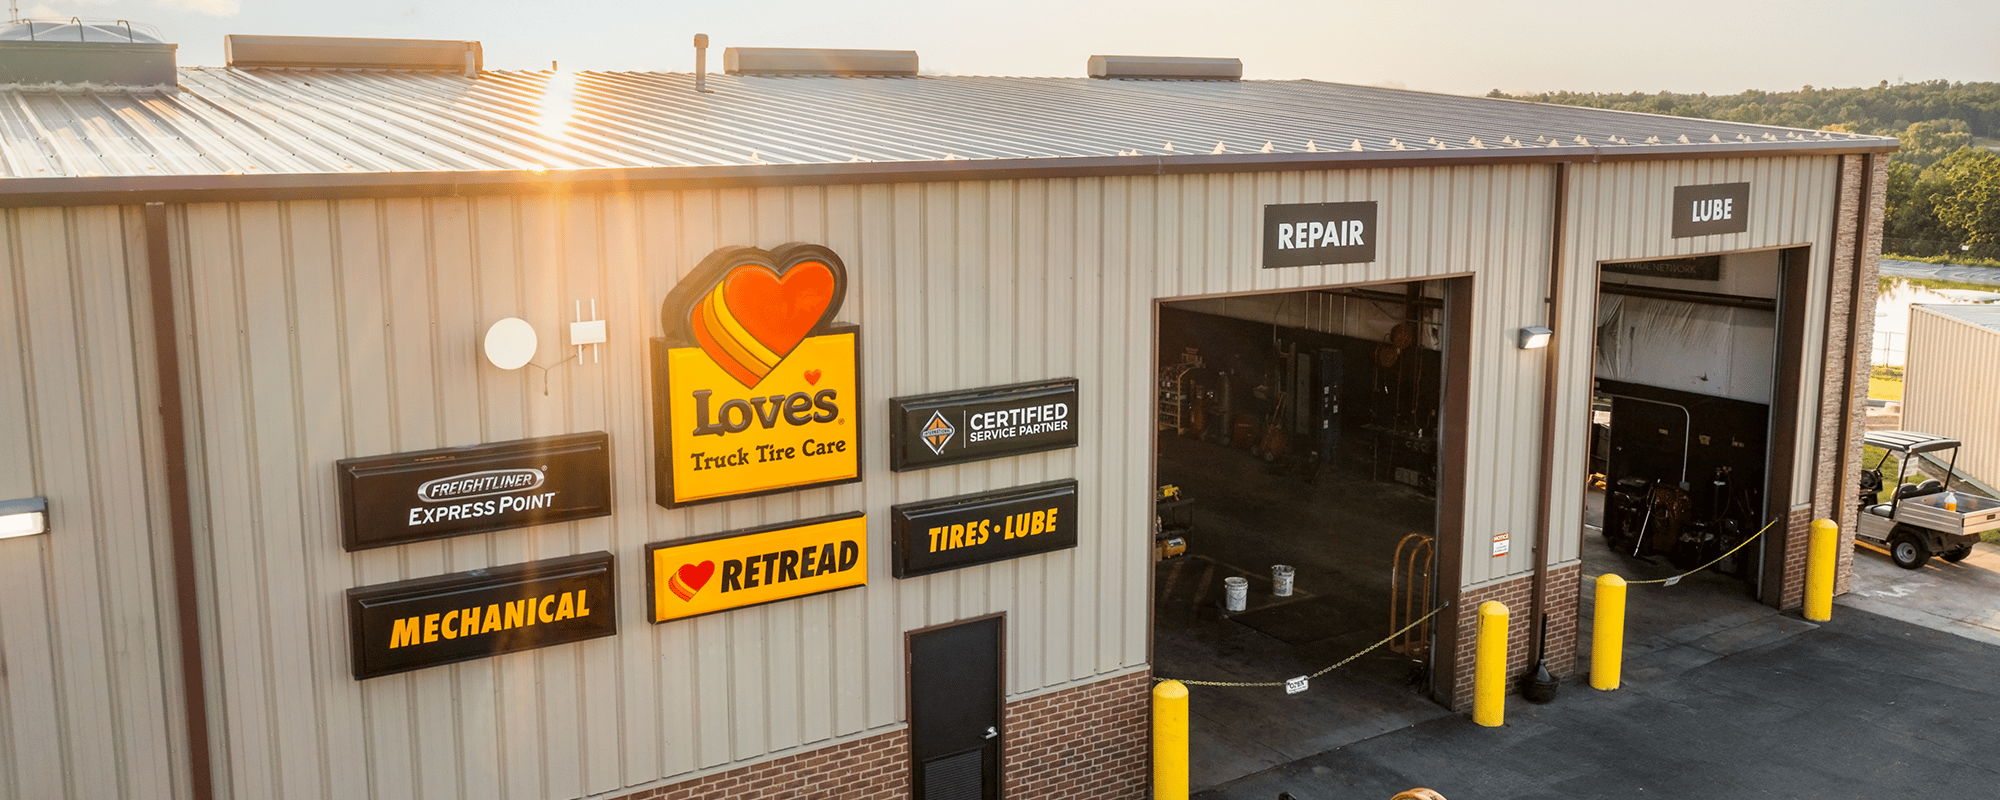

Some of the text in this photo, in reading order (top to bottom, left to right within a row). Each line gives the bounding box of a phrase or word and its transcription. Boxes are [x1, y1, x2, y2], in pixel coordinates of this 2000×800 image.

[1692, 198, 1733, 222] LUBE
[1278, 220, 1365, 250] REPAIR
[1653, 263, 1697, 274] NETWORK
[970, 403, 1068, 431] CERTIFIED
[970, 420, 1068, 443] SERVICE PARTNER
[691, 439, 846, 471] Truck Tire Care
[430, 473, 533, 498] FREIGHTLINER
[408, 493, 556, 526] EXPRESS POINT
[928, 508, 1058, 553] TIRES LUBE
[721, 540, 859, 593] RETREAD
[389, 589, 590, 649] MECHANICAL
